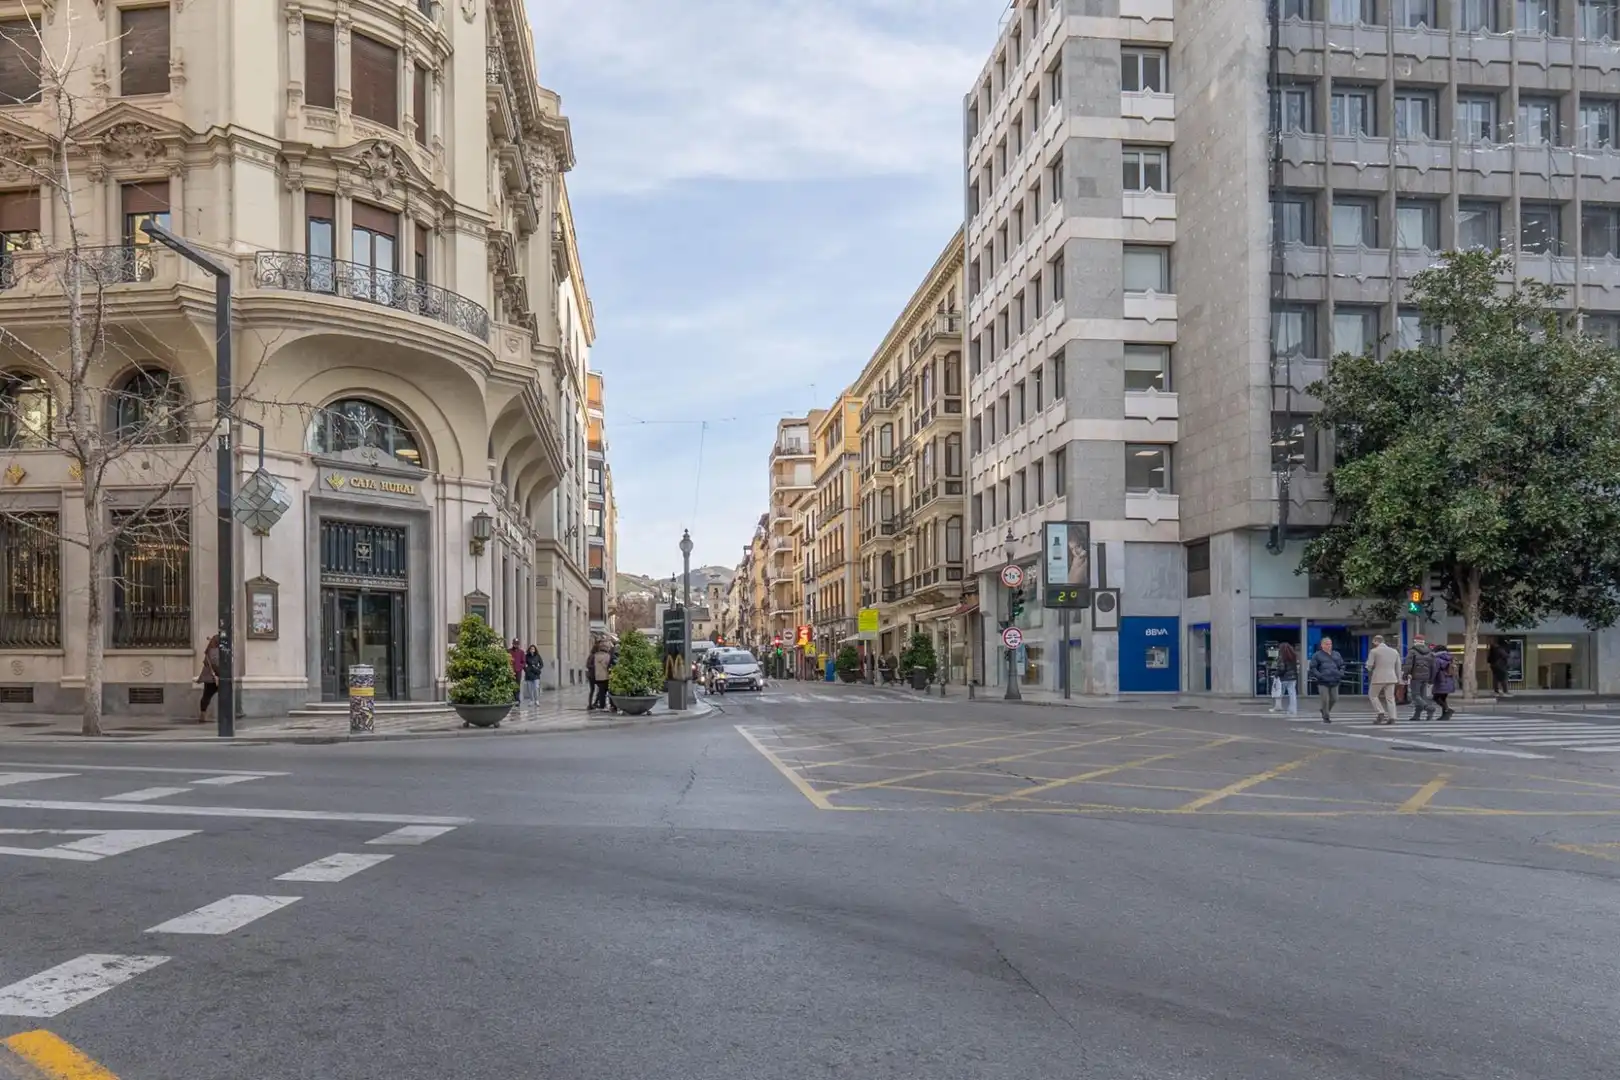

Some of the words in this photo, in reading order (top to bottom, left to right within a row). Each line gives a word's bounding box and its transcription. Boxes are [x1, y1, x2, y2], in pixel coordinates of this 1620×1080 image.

[350, 477, 376, 490] CAJA
[380, 481, 415, 495] RURAL
[1145, 628, 1168, 636] BBVA
